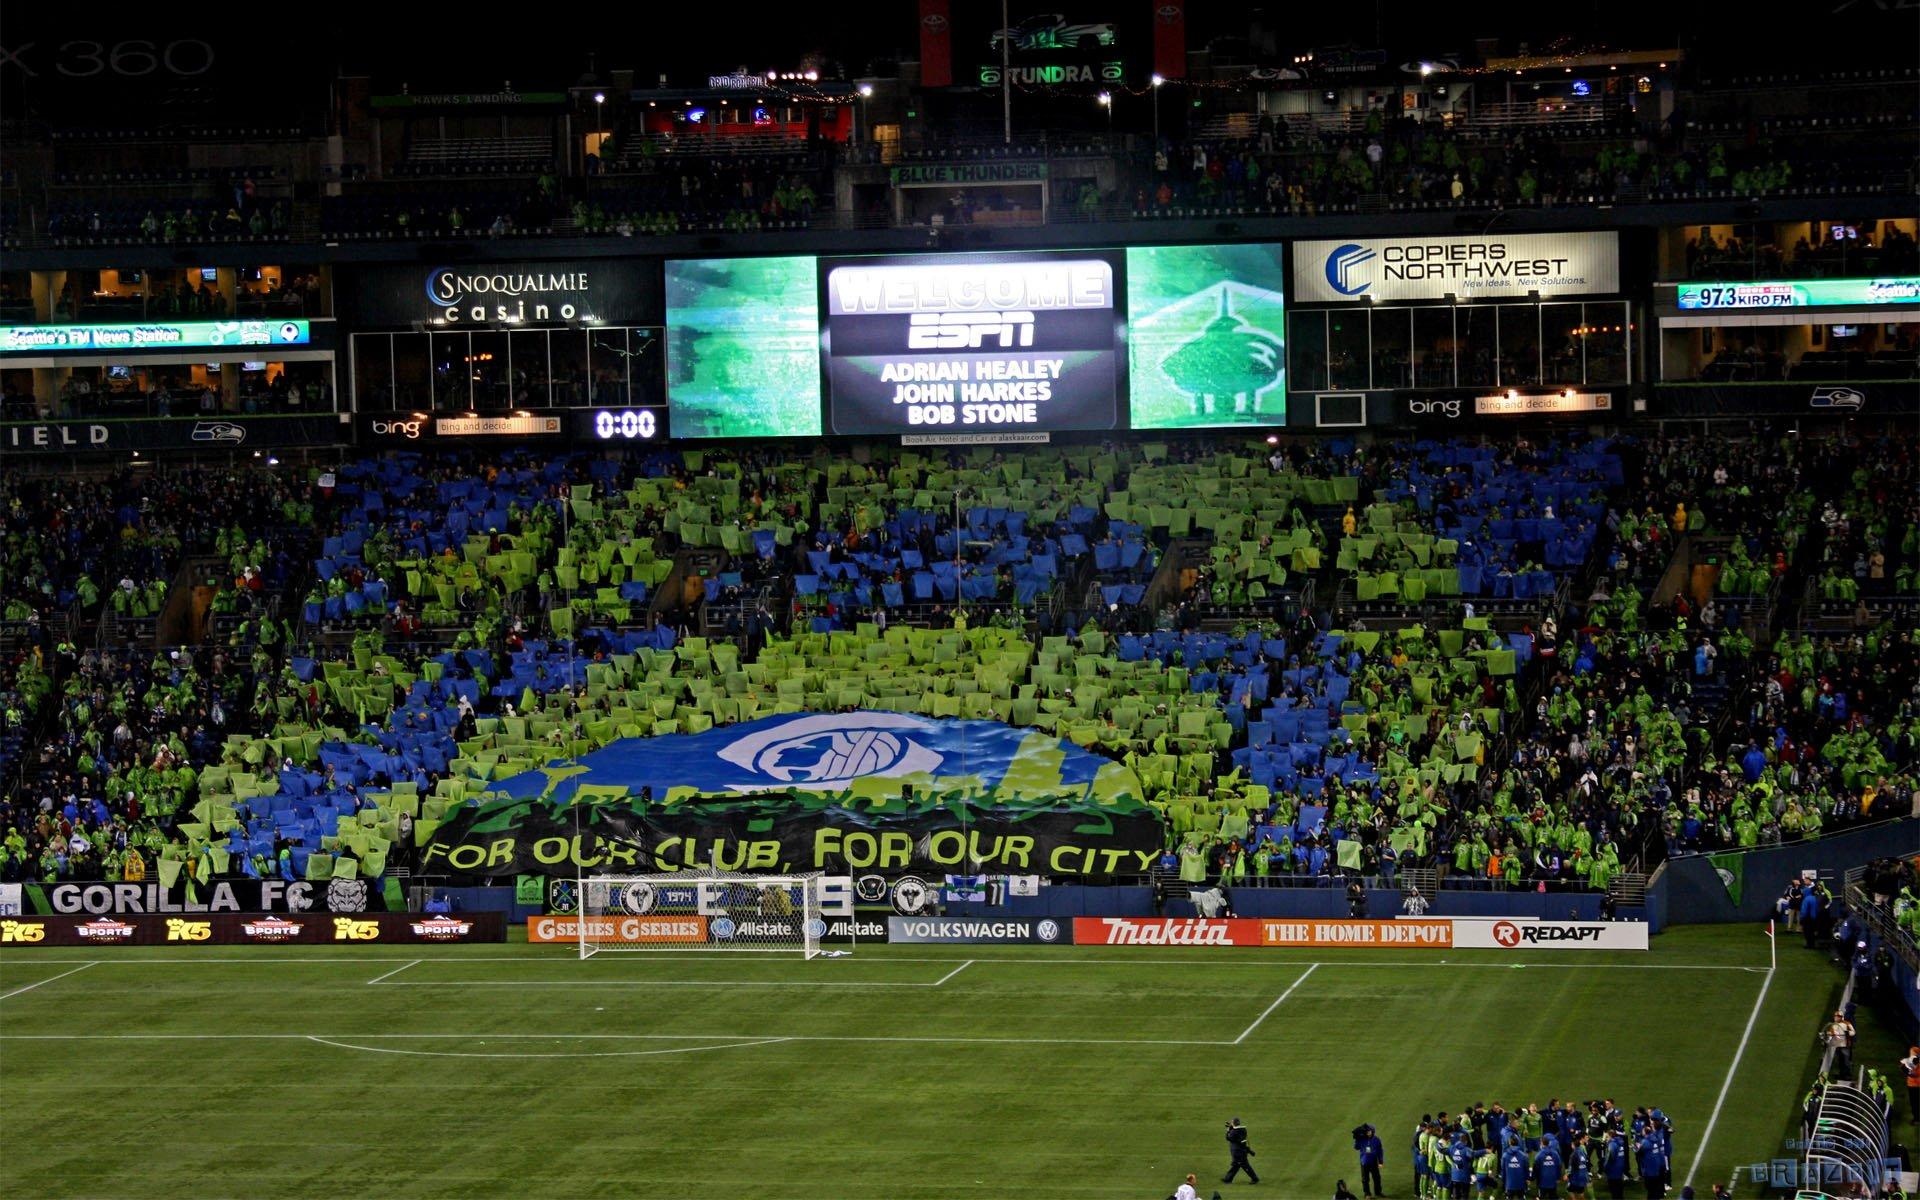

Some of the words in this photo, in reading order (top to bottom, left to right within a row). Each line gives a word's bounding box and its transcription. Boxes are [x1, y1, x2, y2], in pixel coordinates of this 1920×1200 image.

[56, 39, 214, 77] 360
[1010, 65, 1095, 84] TUNDRA
[414, 94, 460, 105] HAWKS
[467, 93, 522, 104] LANDING
[899, 167, 946, 182] BLUE
[950, 164, 1041, 181] THUNDER
[1384, 244, 1506, 262] COPIERS
[1384, 259, 1568, 280] NORTHWEST
[441, 273, 588, 299] SNOQUALMIE
[834, 267, 1105, 312] WELCOME
[1463, 280, 1483, 288] New
[1485, 278, 1512, 288] Ideas.
[1518, 278, 1539, 287] New
[1541, 277, 1587, 286] Solutions.
[1700, 287, 1737, 305] 97.3
[1738, 296, 1770, 305] KIRO
[1773, 294, 1791, 304] FM
[445, 301, 576, 321] casino
[8, 328, 67, 346] Seattle's
[70, 330, 90, 344] FM
[94, 329, 130, 343] News
[134, 326, 181, 342] Station
[908, 311, 1035, 349] ESPN
[881, 362, 969, 382] ADRIAN
[976, 360, 1063, 380] HEALEY
[893, 384, 955, 404] JOHN
[961, 382, 1051, 402] HARKES
[1409, 399, 1461, 417] bing
[1480, 400, 1500, 411] bing
[1503, 399, 1523, 409] and
[1526, 398, 1559, 409] decide
[908, 405, 955, 425] BOB
[962, 404, 1037, 424] STONE
[372, 420, 421, 439] bing
[463, 421, 480, 431] and
[483, 420, 512, 430] decide
[597, 411, 656, 438] 0:00
[905, 434, 923, 443] Book
[939, 434, 959, 443] Hotel
[961, 433, 974, 442] and
[976, 433, 988, 442] Car
[990, 433, 997, 441] at
[999, 432, 1047, 441] alaskaair.com
[422, 837, 517, 870] FOR
[533, 834, 639, 868] OUR
[655, 836, 792, 874] CLUB,
[814, 827, 913, 869] FOR
[930, 829, 1035, 869] OUR
[1051, 844, 1164, 874] CITY
[53, 881, 241, 915] GORILLA
[261, 880, 314, 913] FC
[666, 891, 692, 902] 1974
[78, 927, 133, 937] SPORTS
[244, 926, 300, 936] SPORTS
[413, 925, 470, 935] SPORTS
[903, 922, 1030, 938] VOLKSWAGEN
[1102, 918, 1234, 945] Makita
[1265, 924, 1310, 942] THE
[1314, 924, 1375, 943] HOME
[1380, 924, 1450, 943] DEPOT
[1521, 925, 1606, 942] REDAPT
